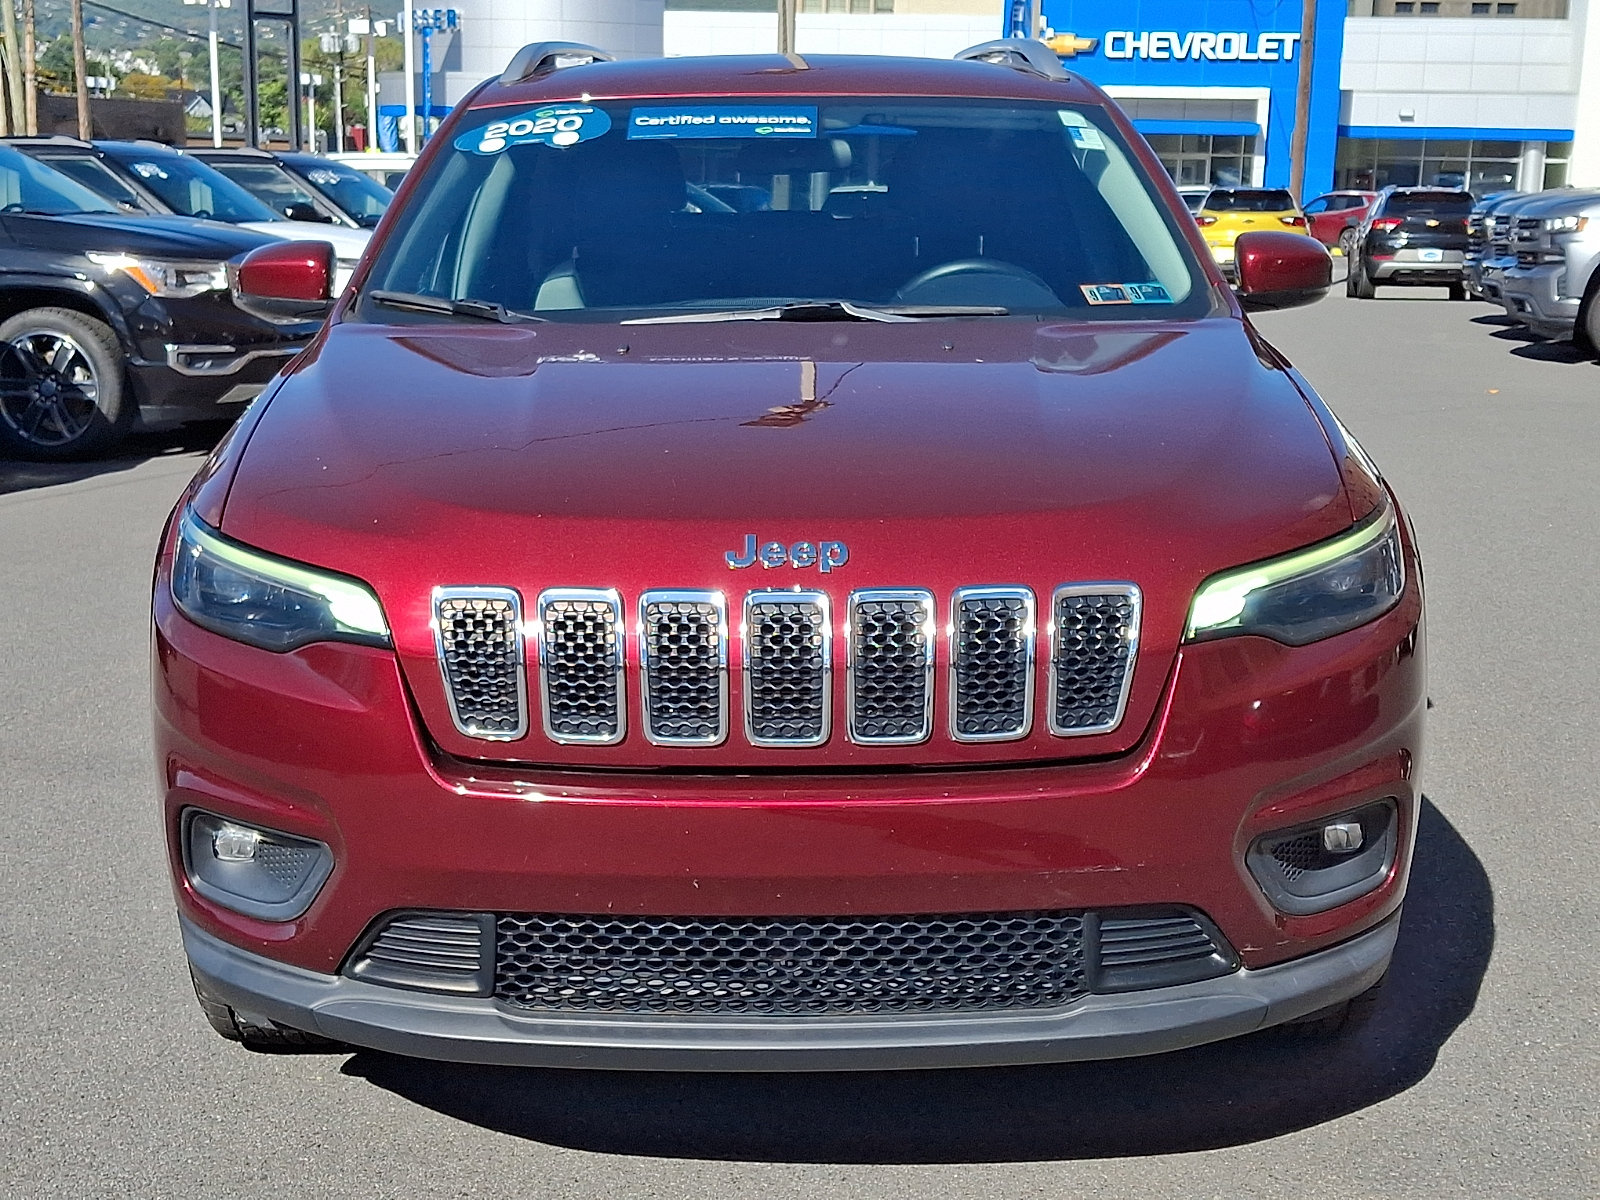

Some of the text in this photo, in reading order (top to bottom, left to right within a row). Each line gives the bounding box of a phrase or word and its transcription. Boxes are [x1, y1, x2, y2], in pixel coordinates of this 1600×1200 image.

[1104, 31, 1300, 60] CHEVROLET
[484, 115, 583, 140] 2020
[634, 115, 812, 126] Certified awesome.
[724, 534, 850, 573] Jeep
